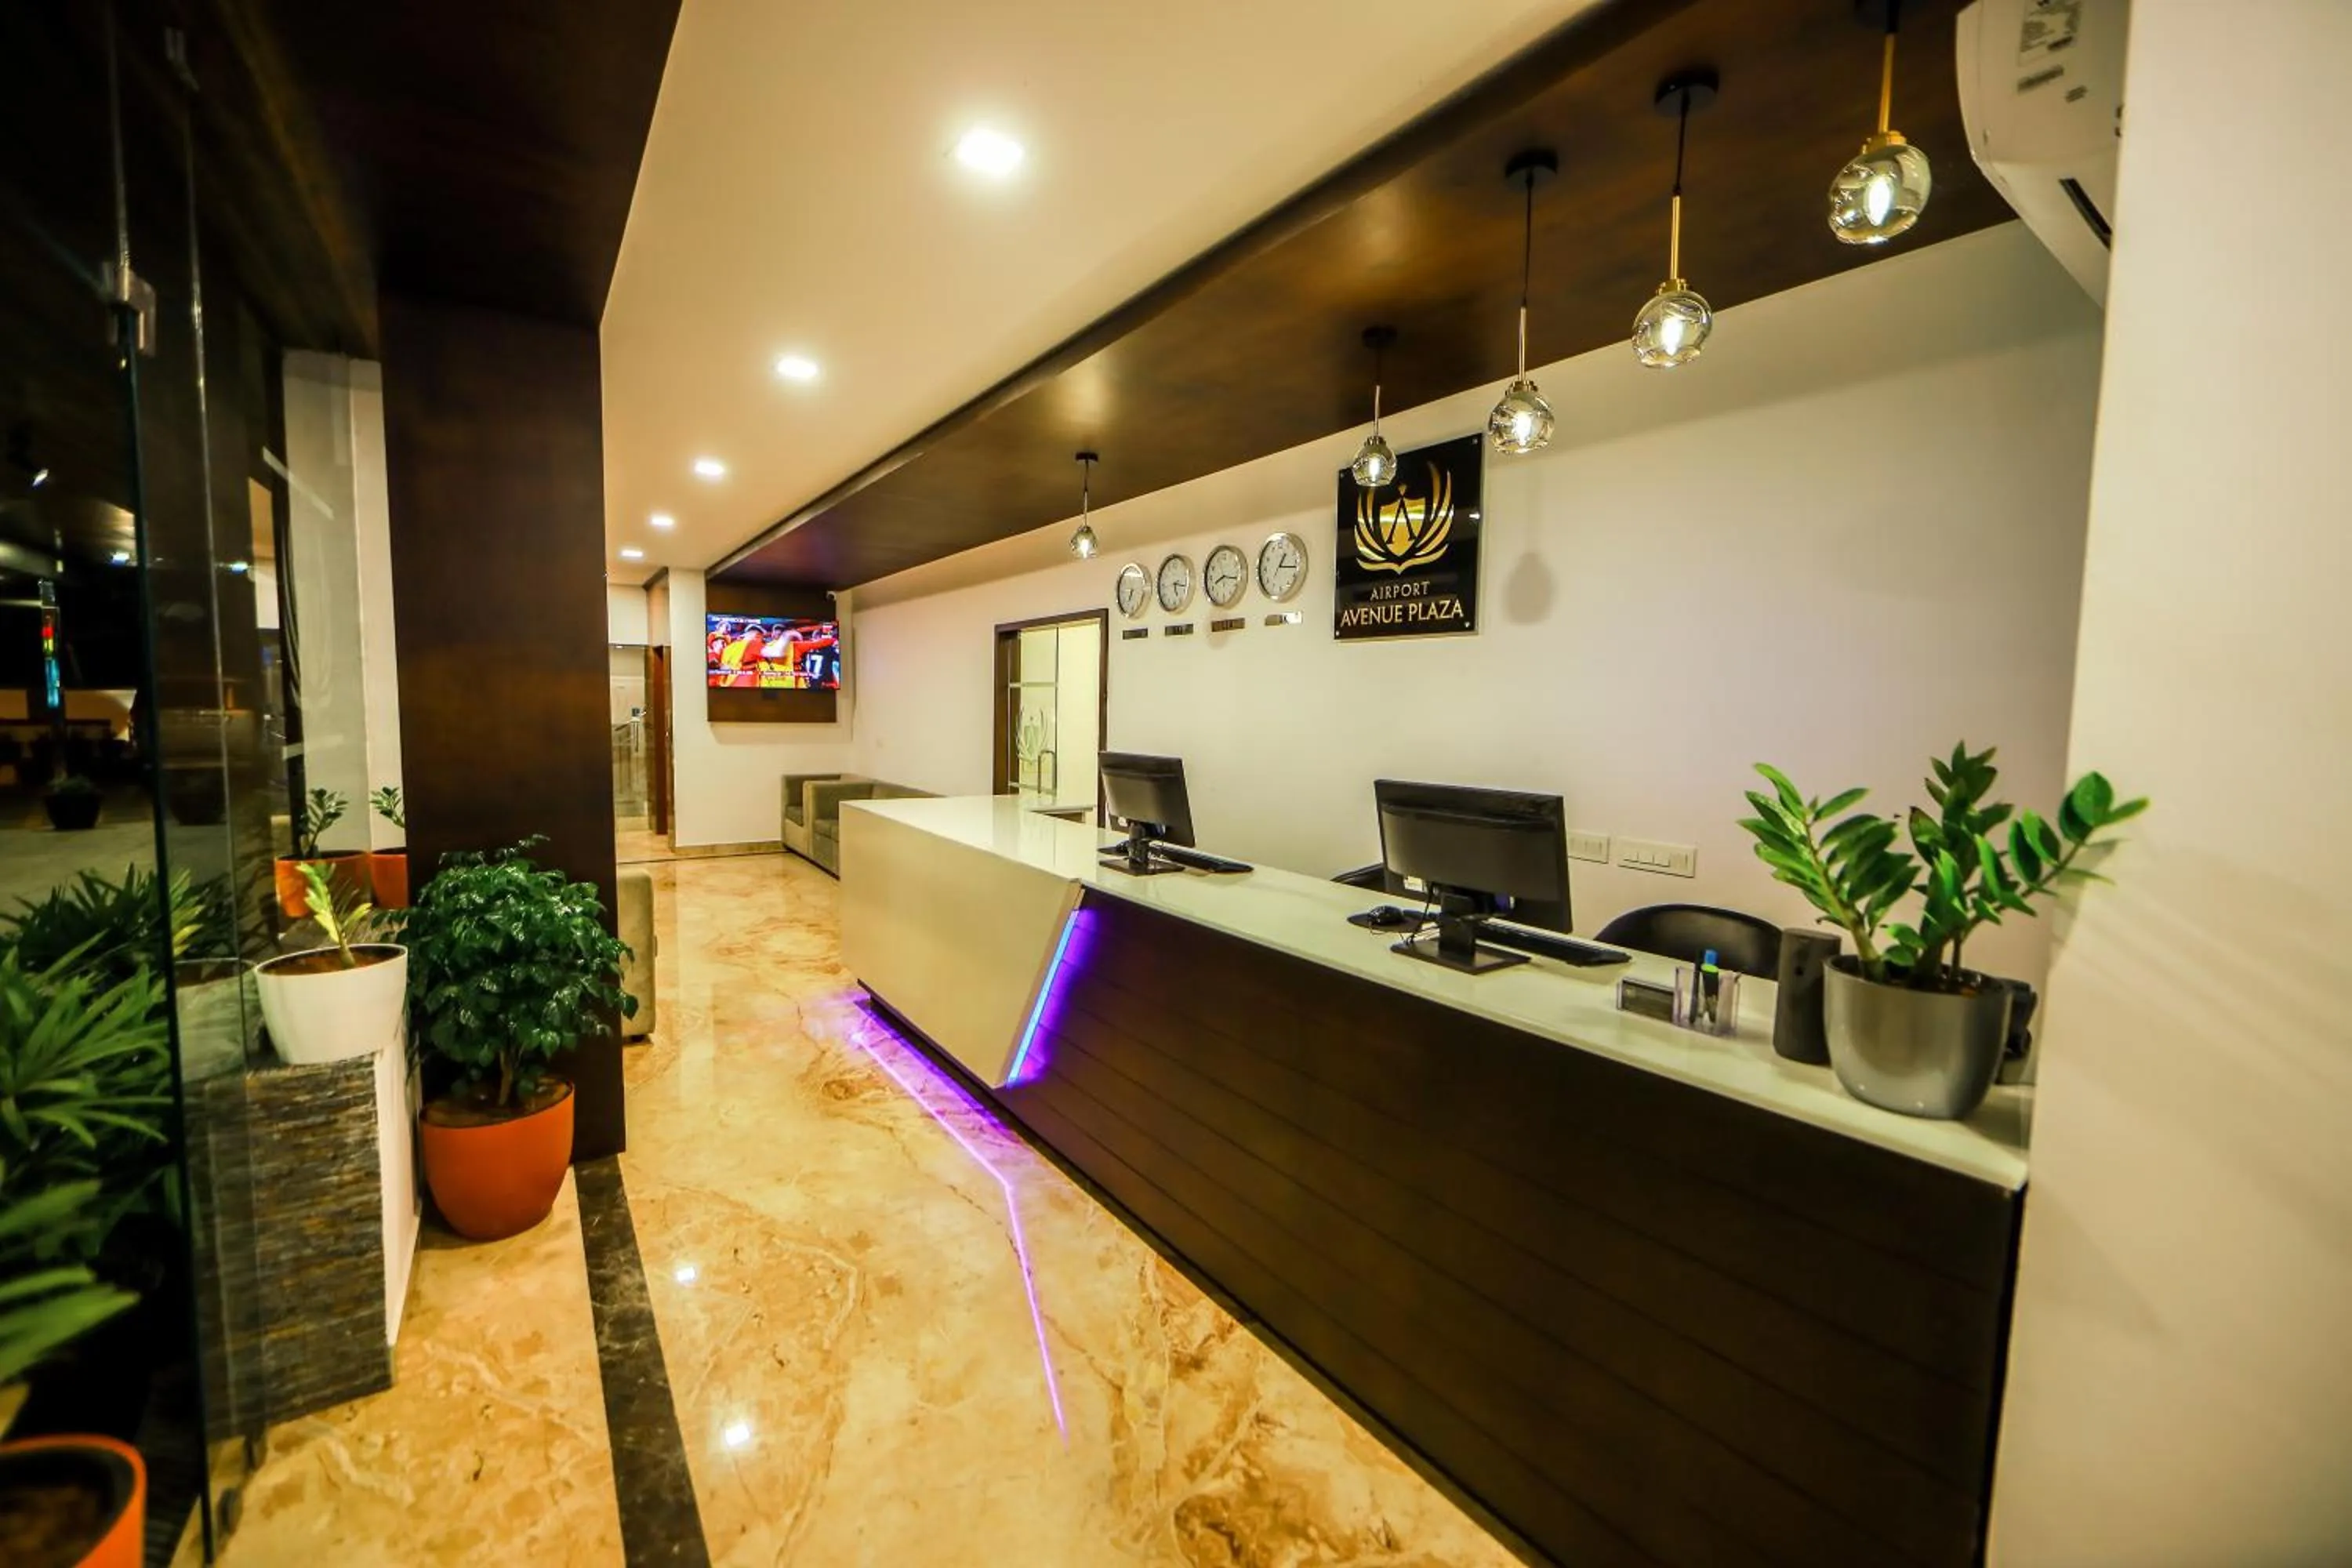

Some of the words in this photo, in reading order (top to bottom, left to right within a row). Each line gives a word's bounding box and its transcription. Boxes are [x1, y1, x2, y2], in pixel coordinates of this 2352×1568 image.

[1370, 581, 1431, 601] AIRPORT
[1340, 604, 1403, 627] AVENUE
[1408, 598, 1465, 622] PLAZA
